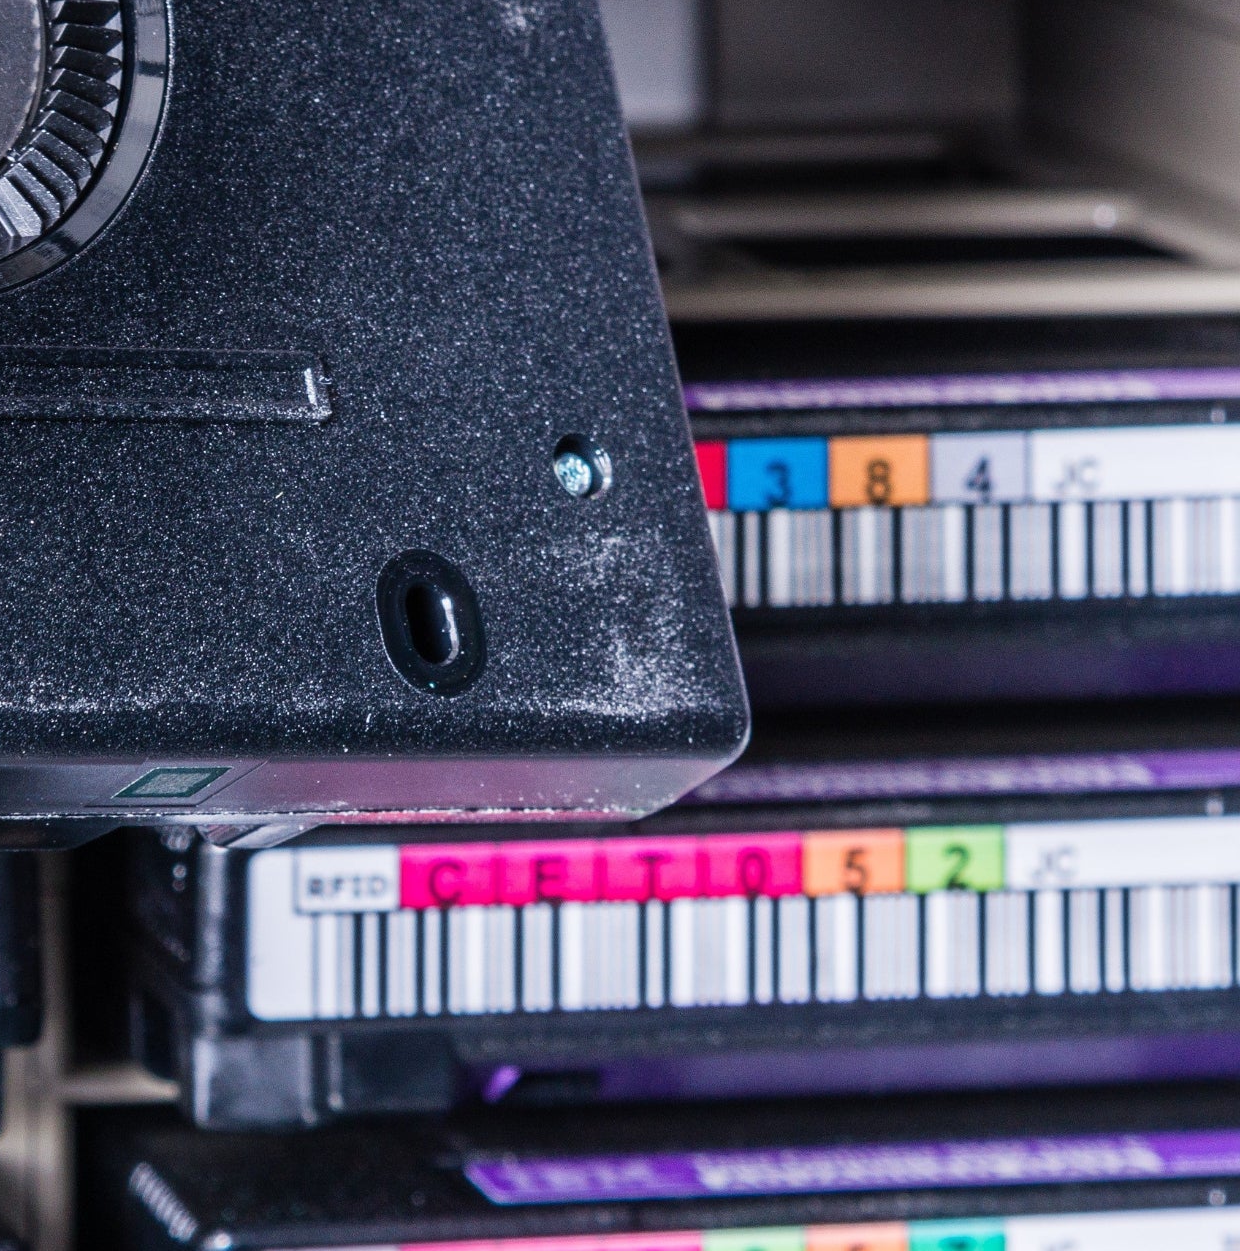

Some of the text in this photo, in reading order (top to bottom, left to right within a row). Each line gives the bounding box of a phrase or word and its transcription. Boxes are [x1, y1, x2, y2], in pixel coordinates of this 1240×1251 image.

[1053, 457, 1103, 492] JC
[307, 874, 387, 899] RFID
[1030, 844, 1079, 883] JC
